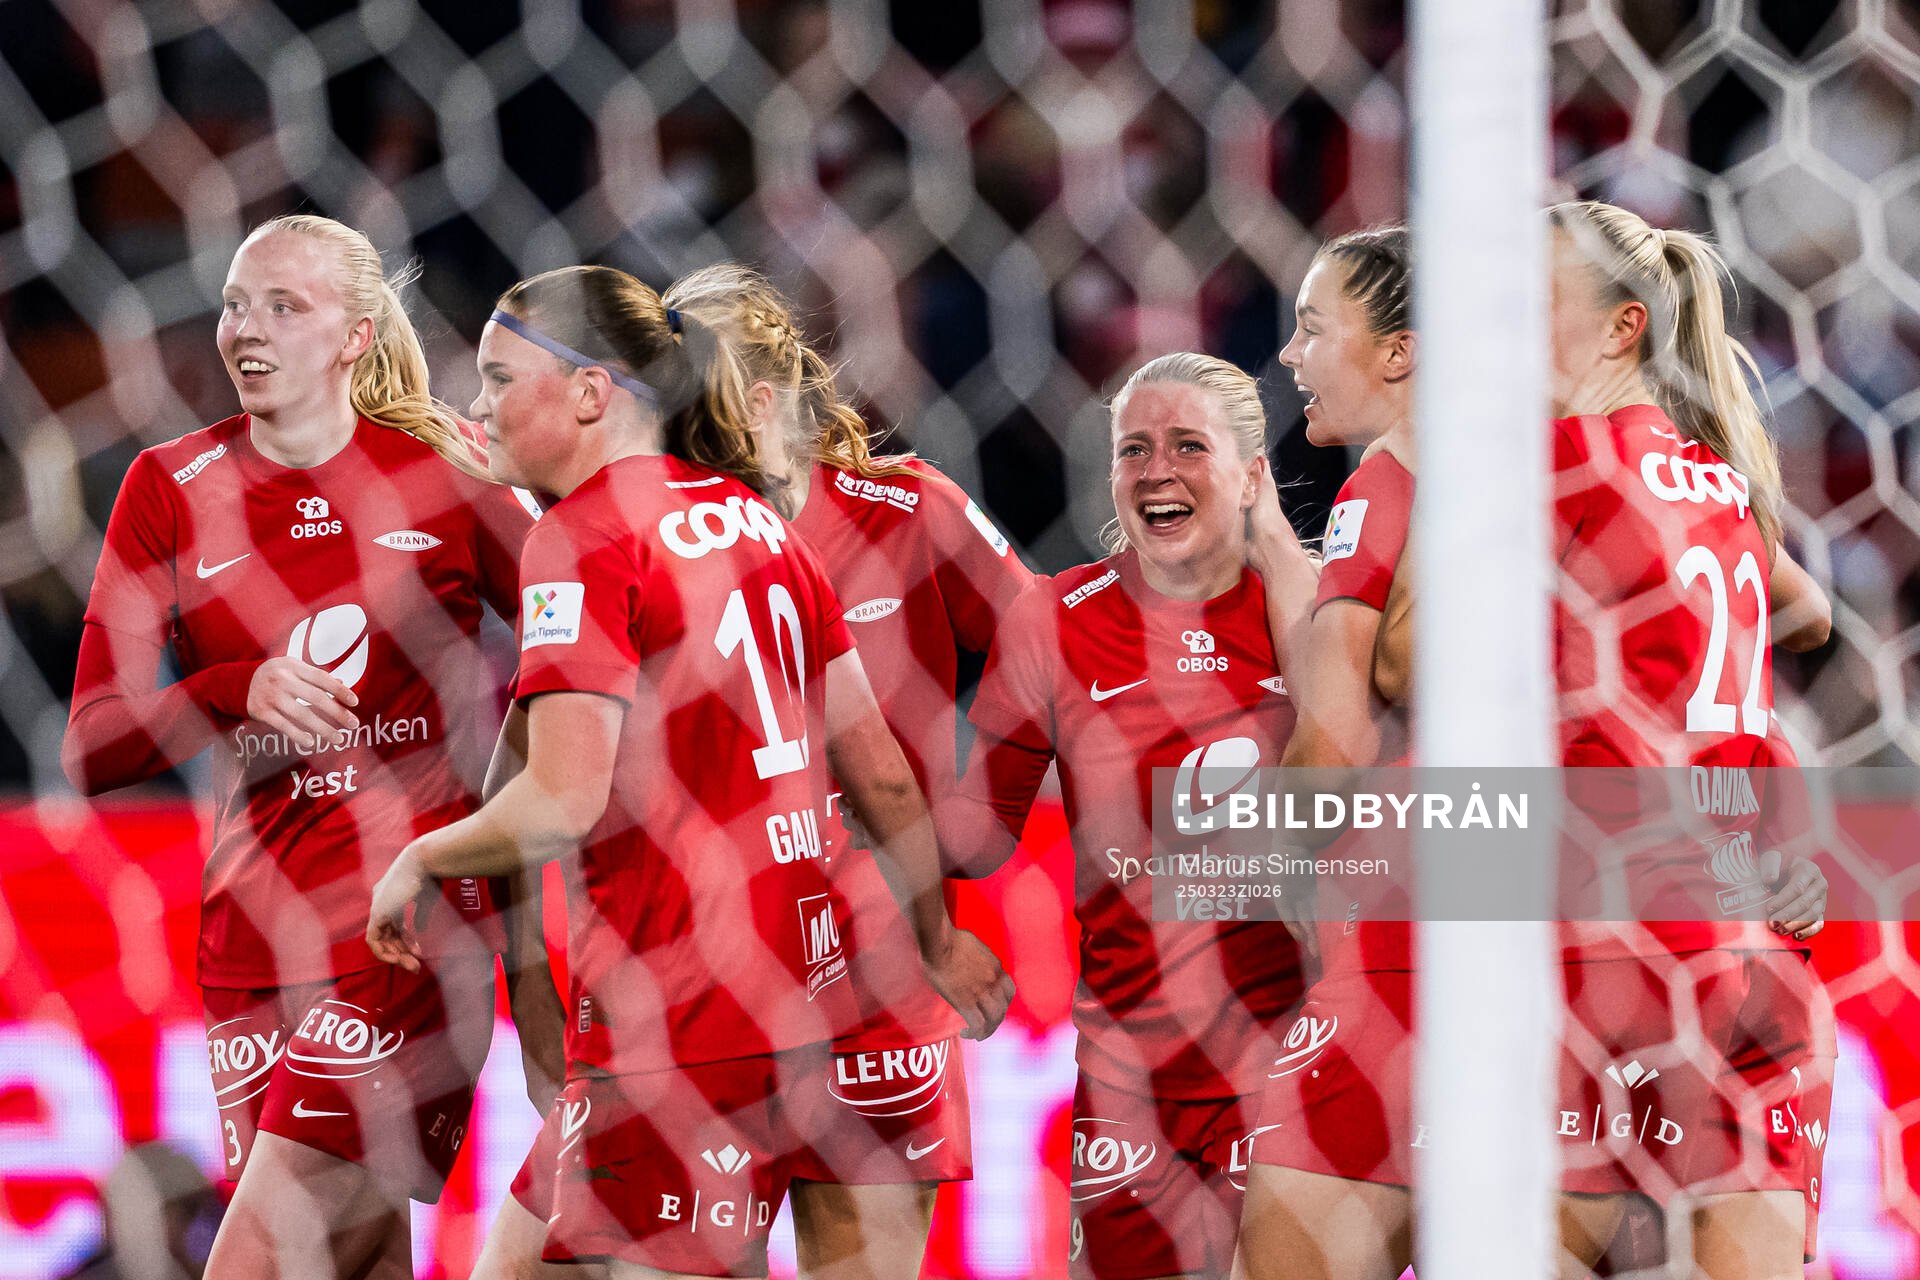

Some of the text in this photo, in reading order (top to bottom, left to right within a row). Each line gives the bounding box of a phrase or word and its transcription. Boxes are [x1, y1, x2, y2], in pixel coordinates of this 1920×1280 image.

[836, 470, 920, 507] FRYDENBØ
[1640, 451, 1750, 519] coop
[290, 519, 343, 540] OBOS
[388, 535, 430, 547] BRANN
[658, 495, 787, 559] coop
[1062, 568, 1117, 607] FRYDENBØ
[854, 601, 894, 619] BRANN
[538, 625, 573, 640] Tipping
[1674, 545, 1772, 739] 22
[713, 583, 810, 781] 10
[1176, 656, 1229, 673] OBOS
[290, 764, 358, 800] Vest
[1174, 889, 1251, 921] Vest
[208, 1030, 280, 1074] ERØY
[836, 1040, 948, 1086] LERØY
[225, 1120, 243, 1166] 3
[1073, 1132, 1147, 1173] RØY
